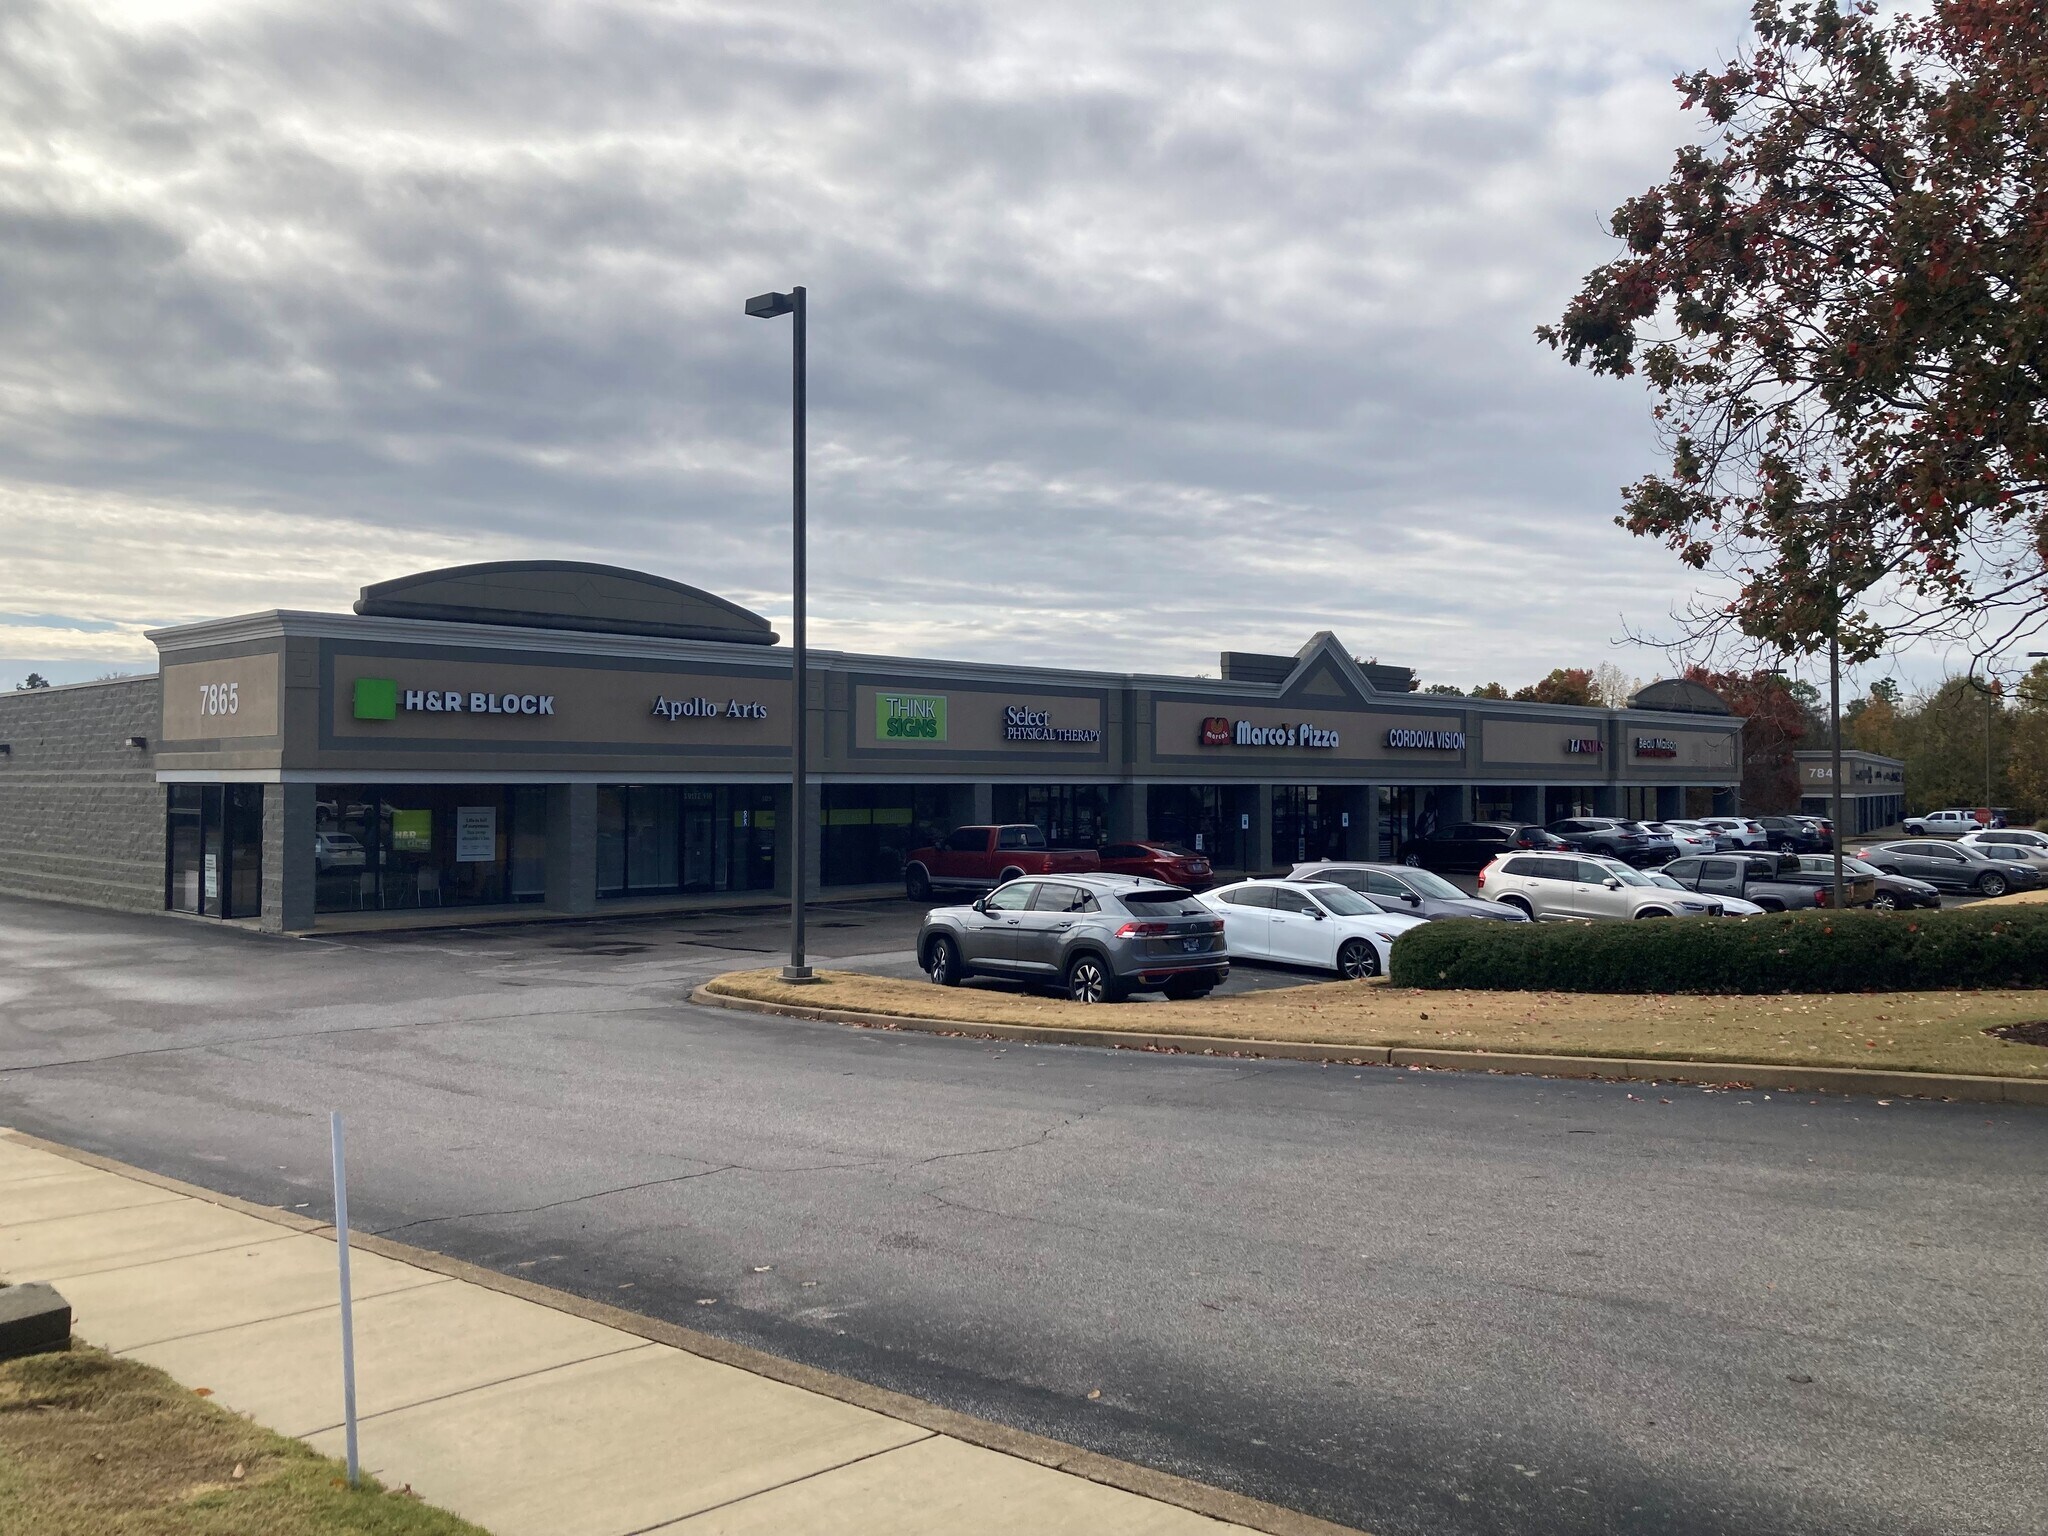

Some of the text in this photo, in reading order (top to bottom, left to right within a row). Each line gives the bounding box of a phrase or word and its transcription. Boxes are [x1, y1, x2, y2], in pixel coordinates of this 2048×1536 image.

[200, 682, 239, 715] 7865
[405, 690, 555, 715] H&R BLOCK
[653, 695, 768, 721] Apollo Arts
[886, 698, 936, 718] THINK
[1007, 705, 1051, 727] Select
[886, 718, 938, 738] SIGNS
[1007, 727, 1102, 743] PHYSICAL THERAPY
[1236, 720, 1339, 748] Marco's Pizza
[1389, 728, 1466, 750] CORDOVA VISION
[1570, 739, 1580, 753] TJ
[1809, 768, 1842, 779] 784
[395, 830, 417, 839] H&R
